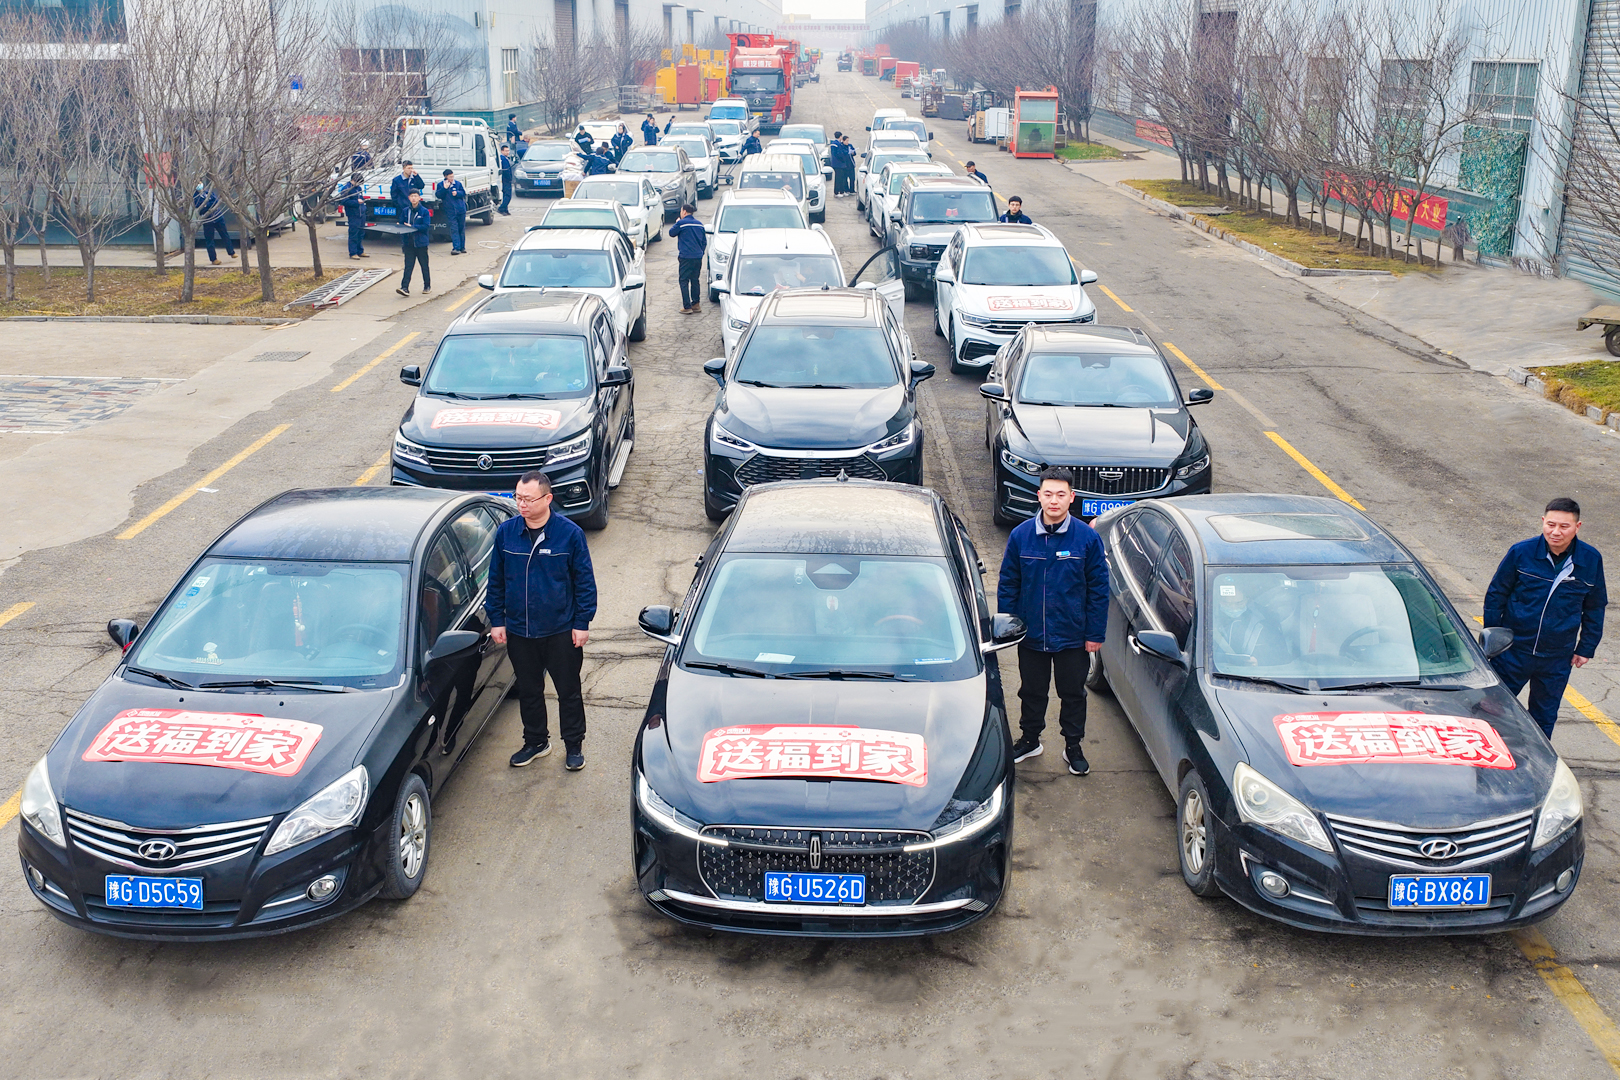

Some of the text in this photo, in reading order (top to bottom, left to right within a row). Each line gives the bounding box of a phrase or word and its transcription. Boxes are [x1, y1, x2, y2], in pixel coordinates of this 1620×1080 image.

[440, 411, 551, 425] 送福到家
[105, 722, 297, 764] 送福到家
[1299, 725, 1495, 759] 送福到家
[717, 740, 909, 774] 送福到家
[109, 881, 200, 904] 豫G·D5C59
[768, 877, 862, 899] 豫G·U526D
[1394, 881, 1484, 902] 豫G·BX861
